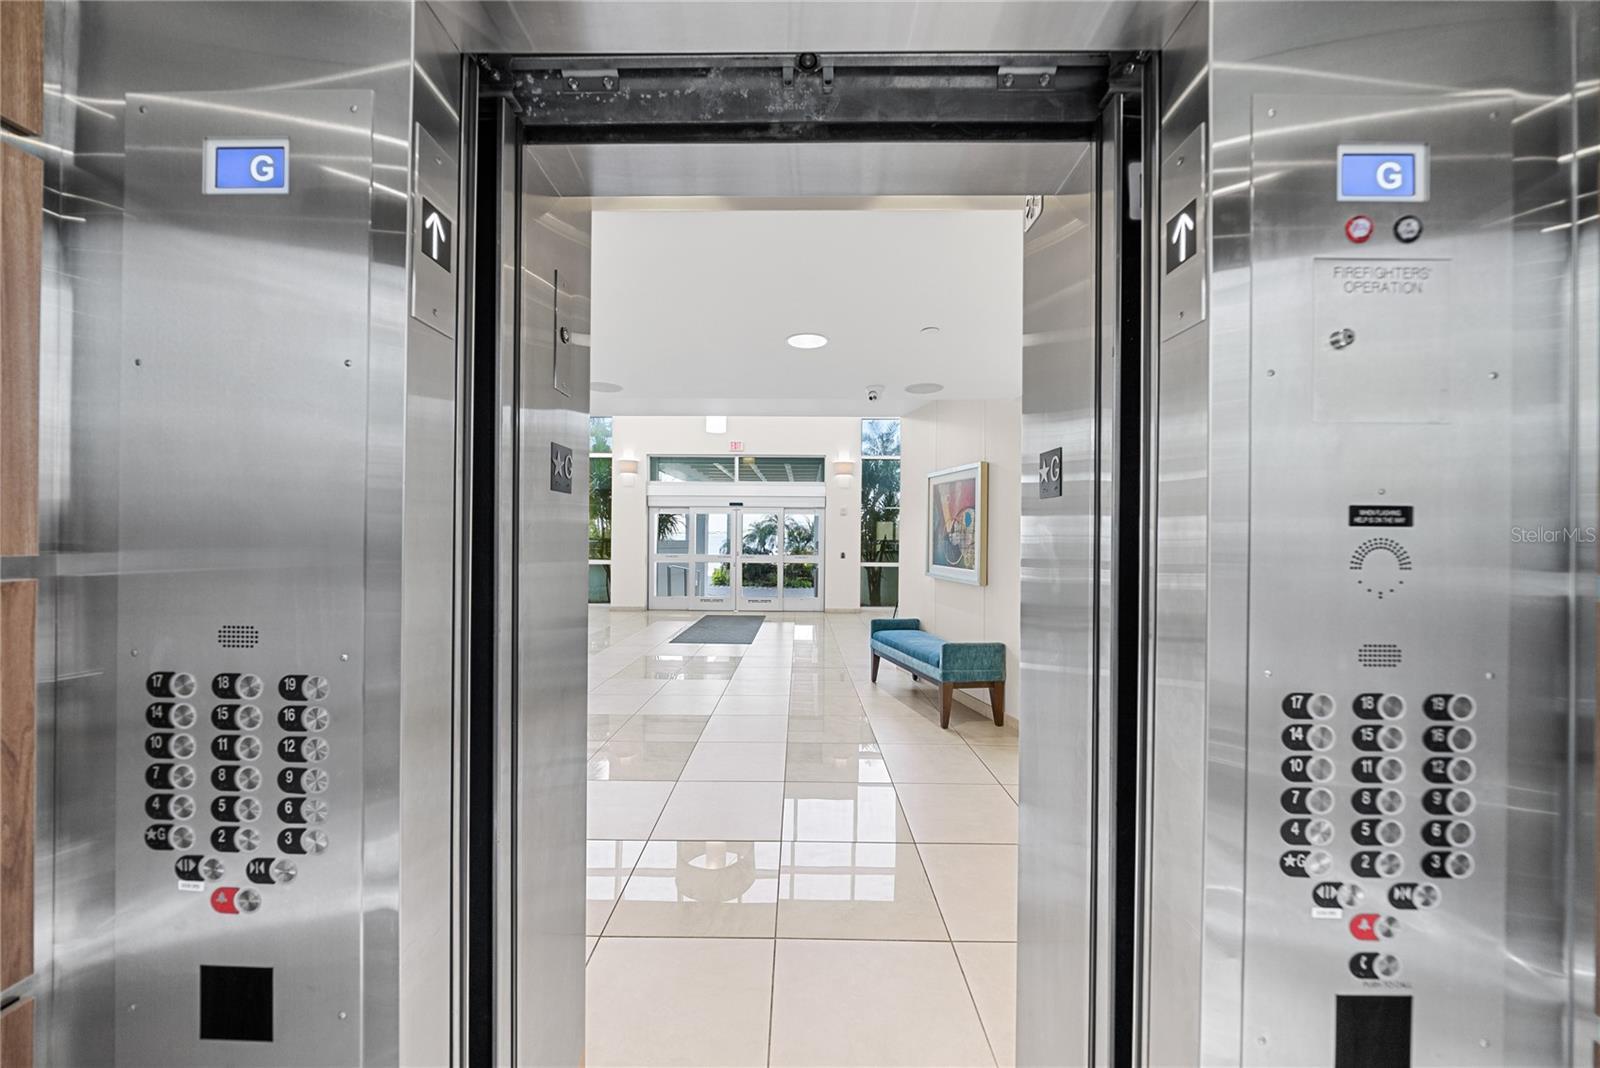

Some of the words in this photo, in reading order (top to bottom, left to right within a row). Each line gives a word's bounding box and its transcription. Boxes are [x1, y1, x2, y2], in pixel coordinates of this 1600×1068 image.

[250, 154, 274, 182] G
[1376, 161, 1402, 190] G
[1343, 280, 1423, 294] OPERATION
[564, 455, 574, 479] G
[1050, 455, 1060, 482] G
[152, 674, 163, 688] 17
[217, 676, 229, 688] 18
[284, 678, 296, 691] 19
[1291, 696, 1304, 709] 17
[151, 706, 162, 718] 14
[216, 707, 228, 720] 15
[283, 708, 296, 722] 16
[1289, 727, 1303, 741] 14
[1360, 728, 1374, 741] 15
[150, 736, 162, 749] 10
[218, 738, 228, 750] 11
[283, 739, 296, 752] 12
[1289, 758, 1303, 772] 10
[1361, 760, 1372, 774] 11
[153, 766, 160, 779] 7
[218, 768, 226, 781] 8
[285, 770, 293, 783] 9
[152, 797, 160, 810] 4
[1292, 790, 1300, 804] 7
[218, 799, 226, 812] 5
[285, 801, 292, 814] 6
[1290, 822, 1300, 836] 4
[1361, 823, 1370, 836] 5
[218, 830, 226, 843] 2
[284, 832, 292, 845] 3
[1361, 855, 1370, 868] 2
[1431, 855, 1441, 869] 3
